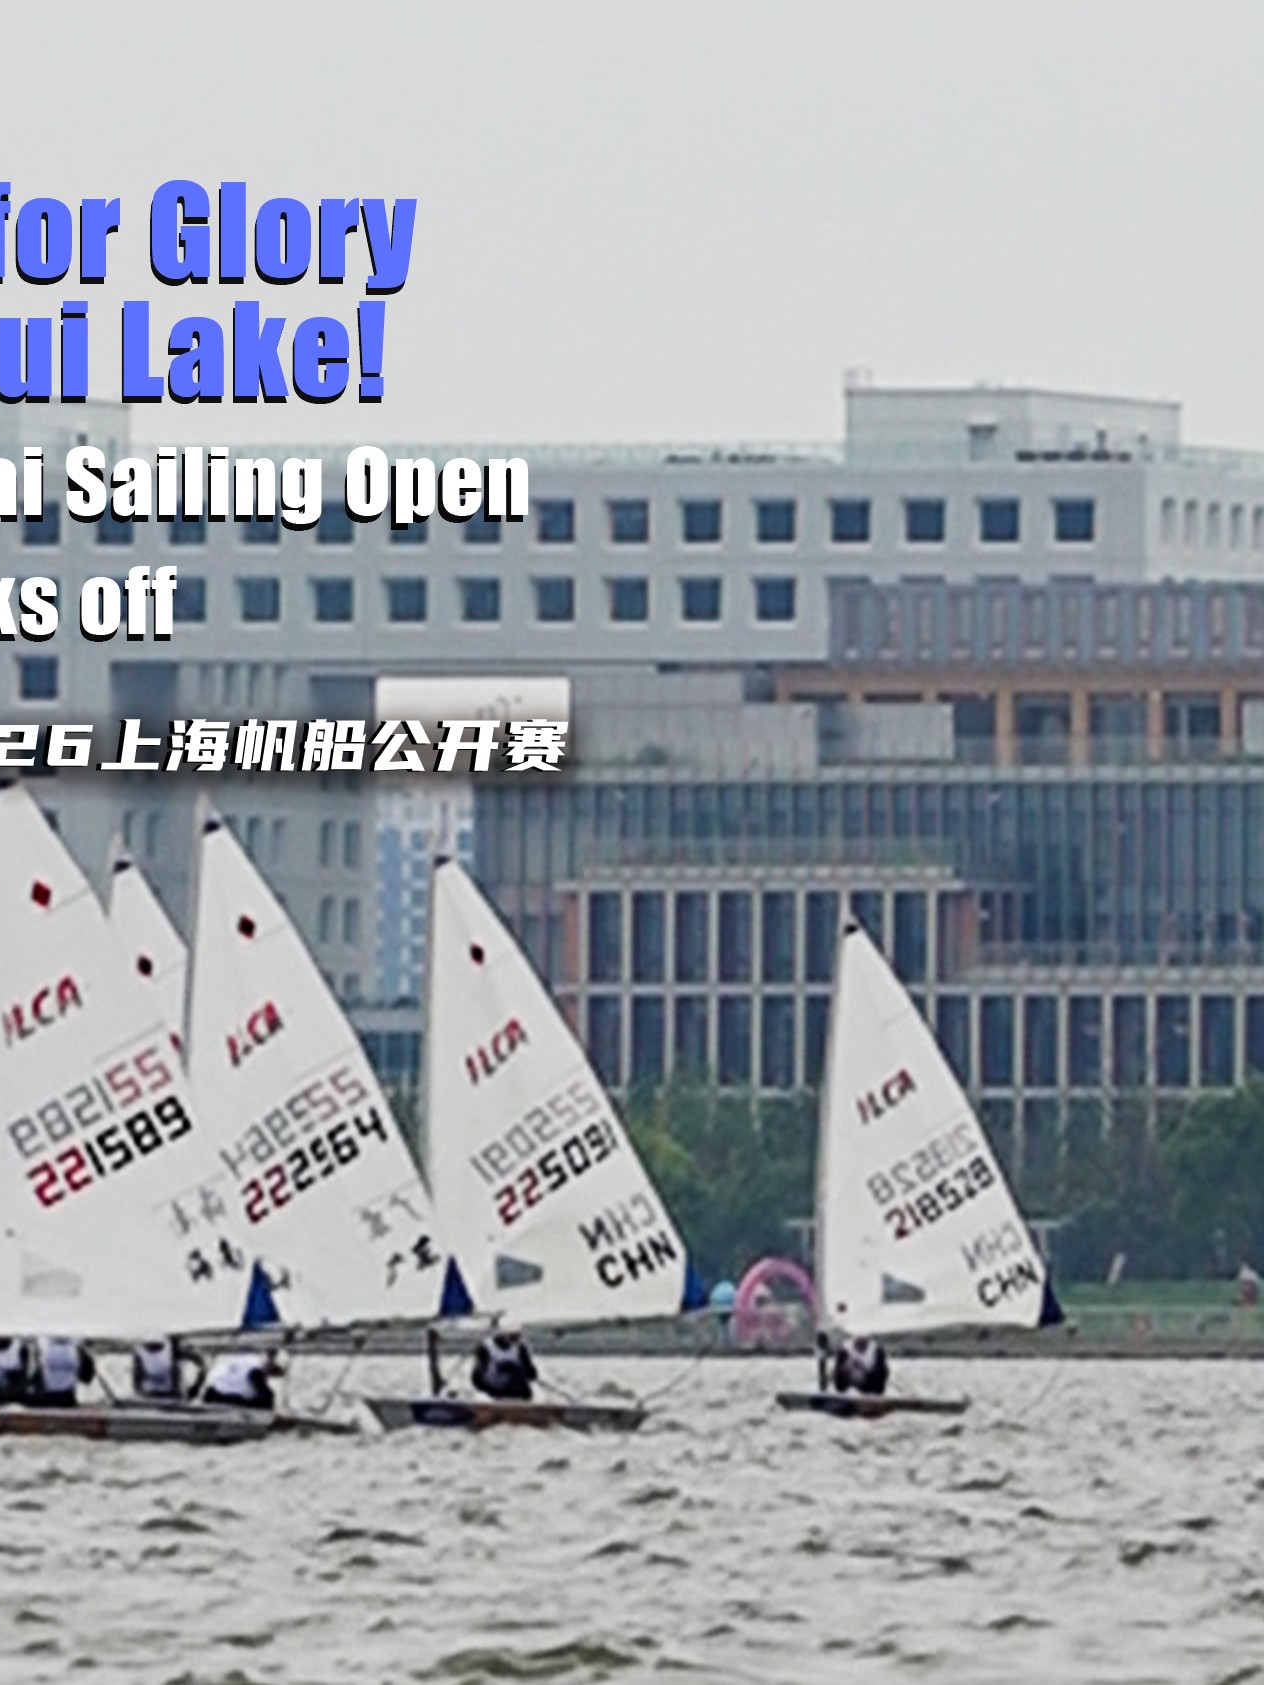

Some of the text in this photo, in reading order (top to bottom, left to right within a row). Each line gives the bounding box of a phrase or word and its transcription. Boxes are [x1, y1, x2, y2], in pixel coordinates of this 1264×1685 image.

[2, 975, 82, 1048] ILCA
[465, 1017, 528, 1085] ILCA
[857, 1068, 916, 1125] ILCA
[27, 1095, 191, 1208] 221589
[495, 1117, 618, 1226] 225091
[885, 1155, 994, 1240] 218528
[596, 1230, 676, 1288] CHN
[977, 1258, 1040, 1308] CHN
